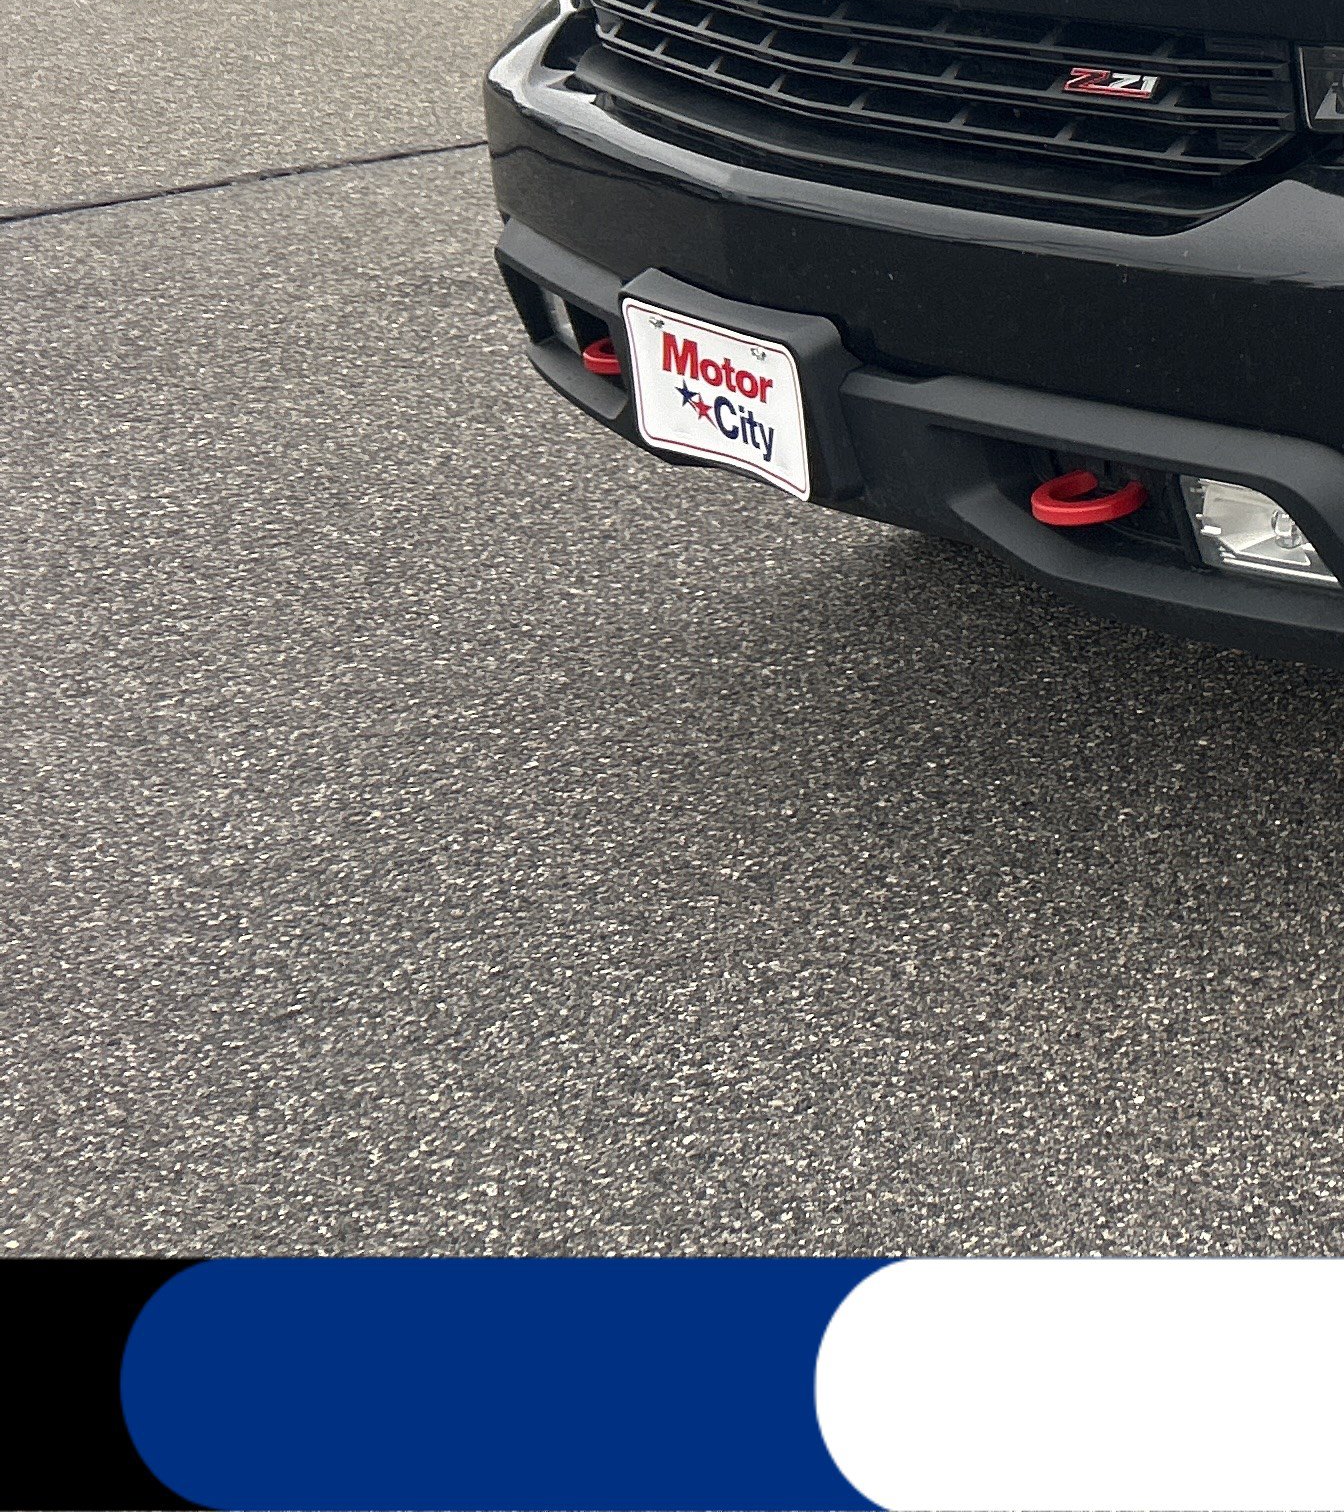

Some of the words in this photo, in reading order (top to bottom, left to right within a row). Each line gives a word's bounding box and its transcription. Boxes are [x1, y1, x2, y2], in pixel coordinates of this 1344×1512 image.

[1064, 67, 1158, 99] Z71
[662, 331, 773, 404] Motor
[714, 395, 774, 463] City
